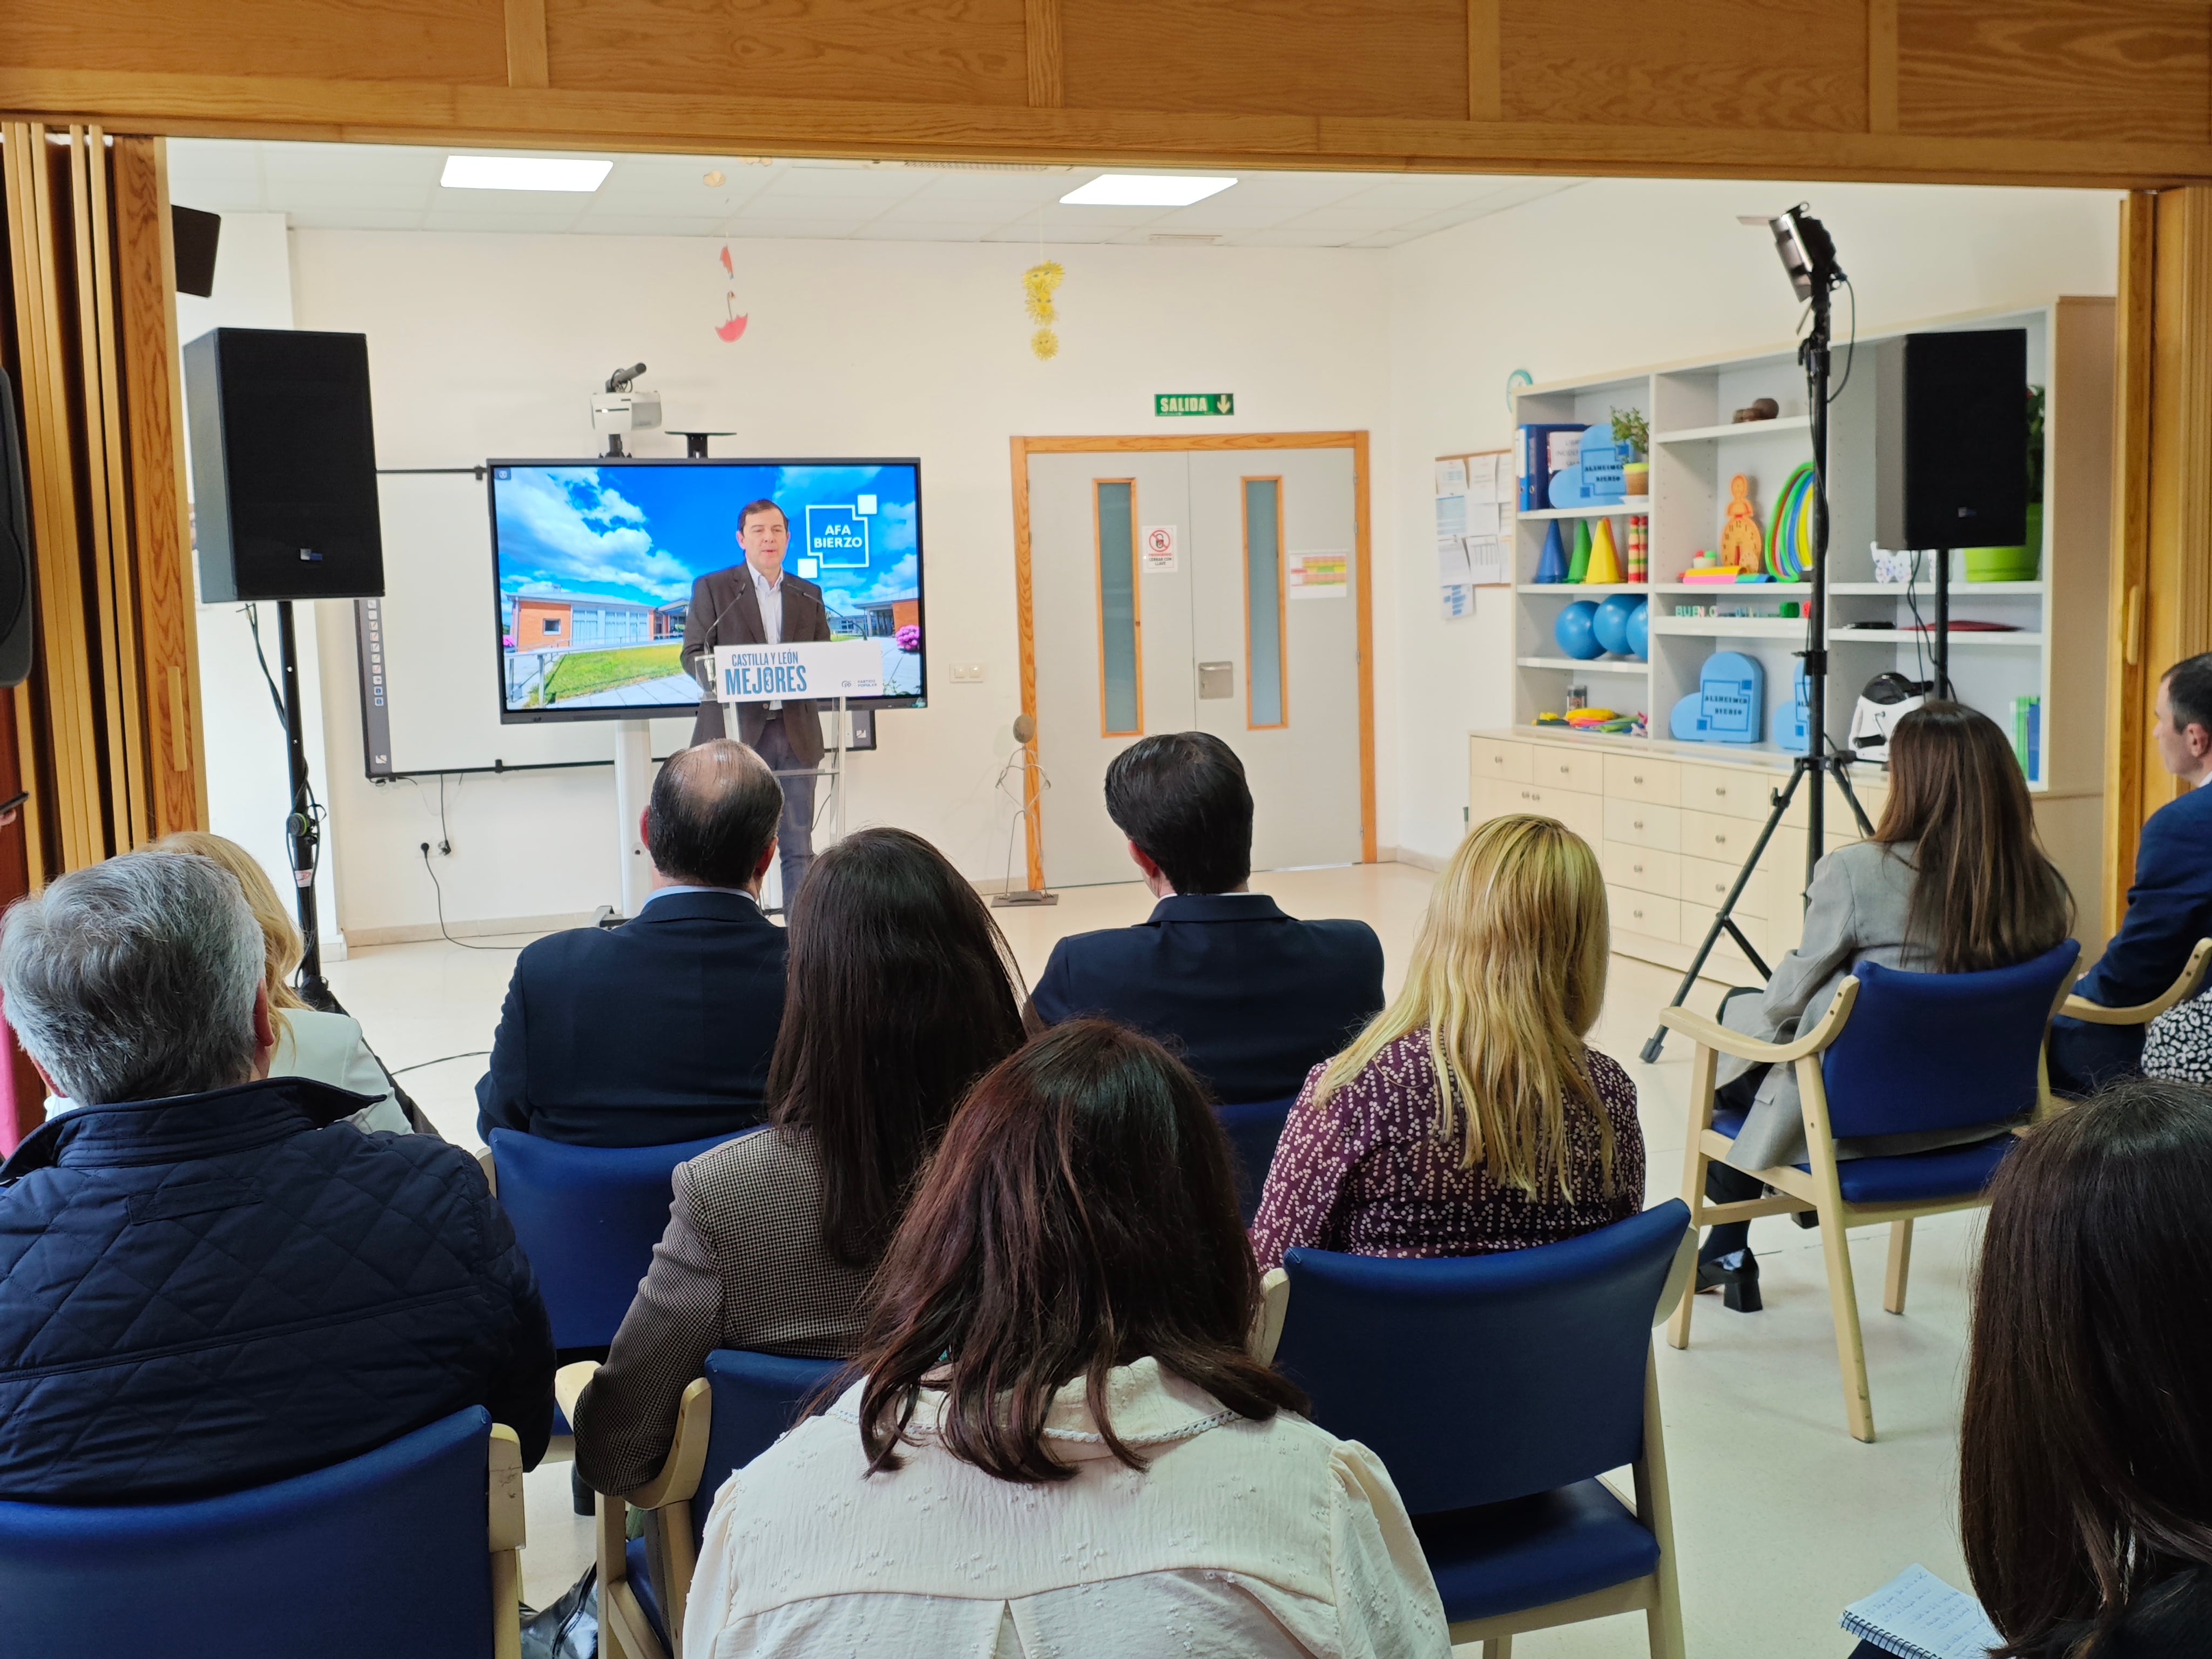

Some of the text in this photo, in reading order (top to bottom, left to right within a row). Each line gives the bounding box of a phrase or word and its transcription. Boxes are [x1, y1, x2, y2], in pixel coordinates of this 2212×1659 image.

[1160, 397, 1208, 412] SALIDA
[825, 524, 851, 536] AFA
[814, 537, 863, 548] BIERZO
[732, 649, 799, 667] CASTILLA Y LEÓN
[725, 665, 807, 696] MEJORES
[1705, 696, 1747, 704] ALZHEIMER
